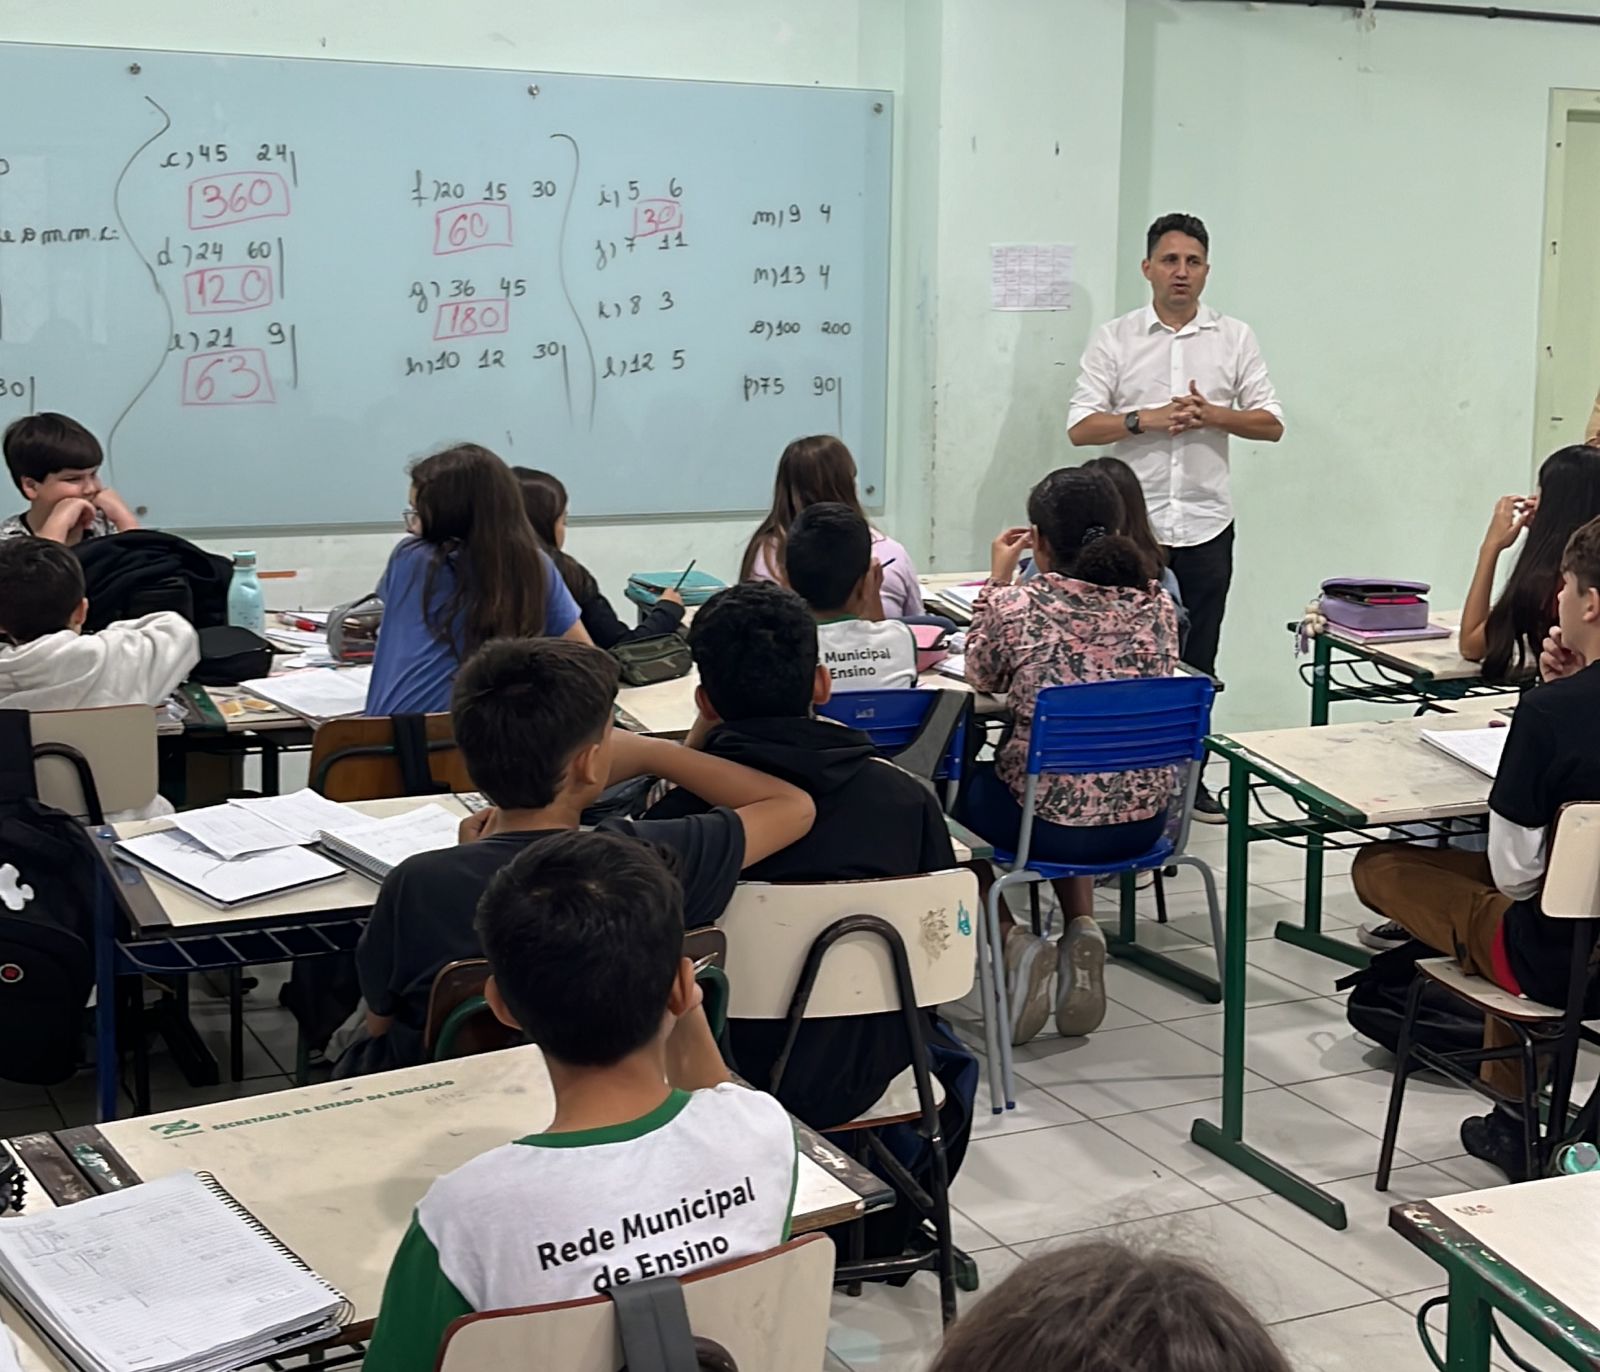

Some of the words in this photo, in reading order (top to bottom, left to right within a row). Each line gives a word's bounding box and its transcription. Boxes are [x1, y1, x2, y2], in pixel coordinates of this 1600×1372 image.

[202, 179, 273, 219] 360
[532, 179, 557, 198] 30
[448, 211, 489, 247] 60
[197, 268, 268, 307] 120
[450, 303, 501, 334] 180
[820, 320, 852, 337] 200
[195, 354, 261, 402] 63
[824, 647, 892, 664] Municipal
[829, 664, 877, 680] Ensino
[211, 1111, 291, 1131] SECRETARIA
[293, 1107, 312, 1116] DE
[314, 1097, 364, 1112] ESTADO
[366, 1093, 387, 1102] DA
[536, 1227, 615, 1271] Rede
[621, 1175, 756, 1245] Municipal
[593, 1264, 631, 1294] de
[635, 1235, 729, 1280] Ensino
